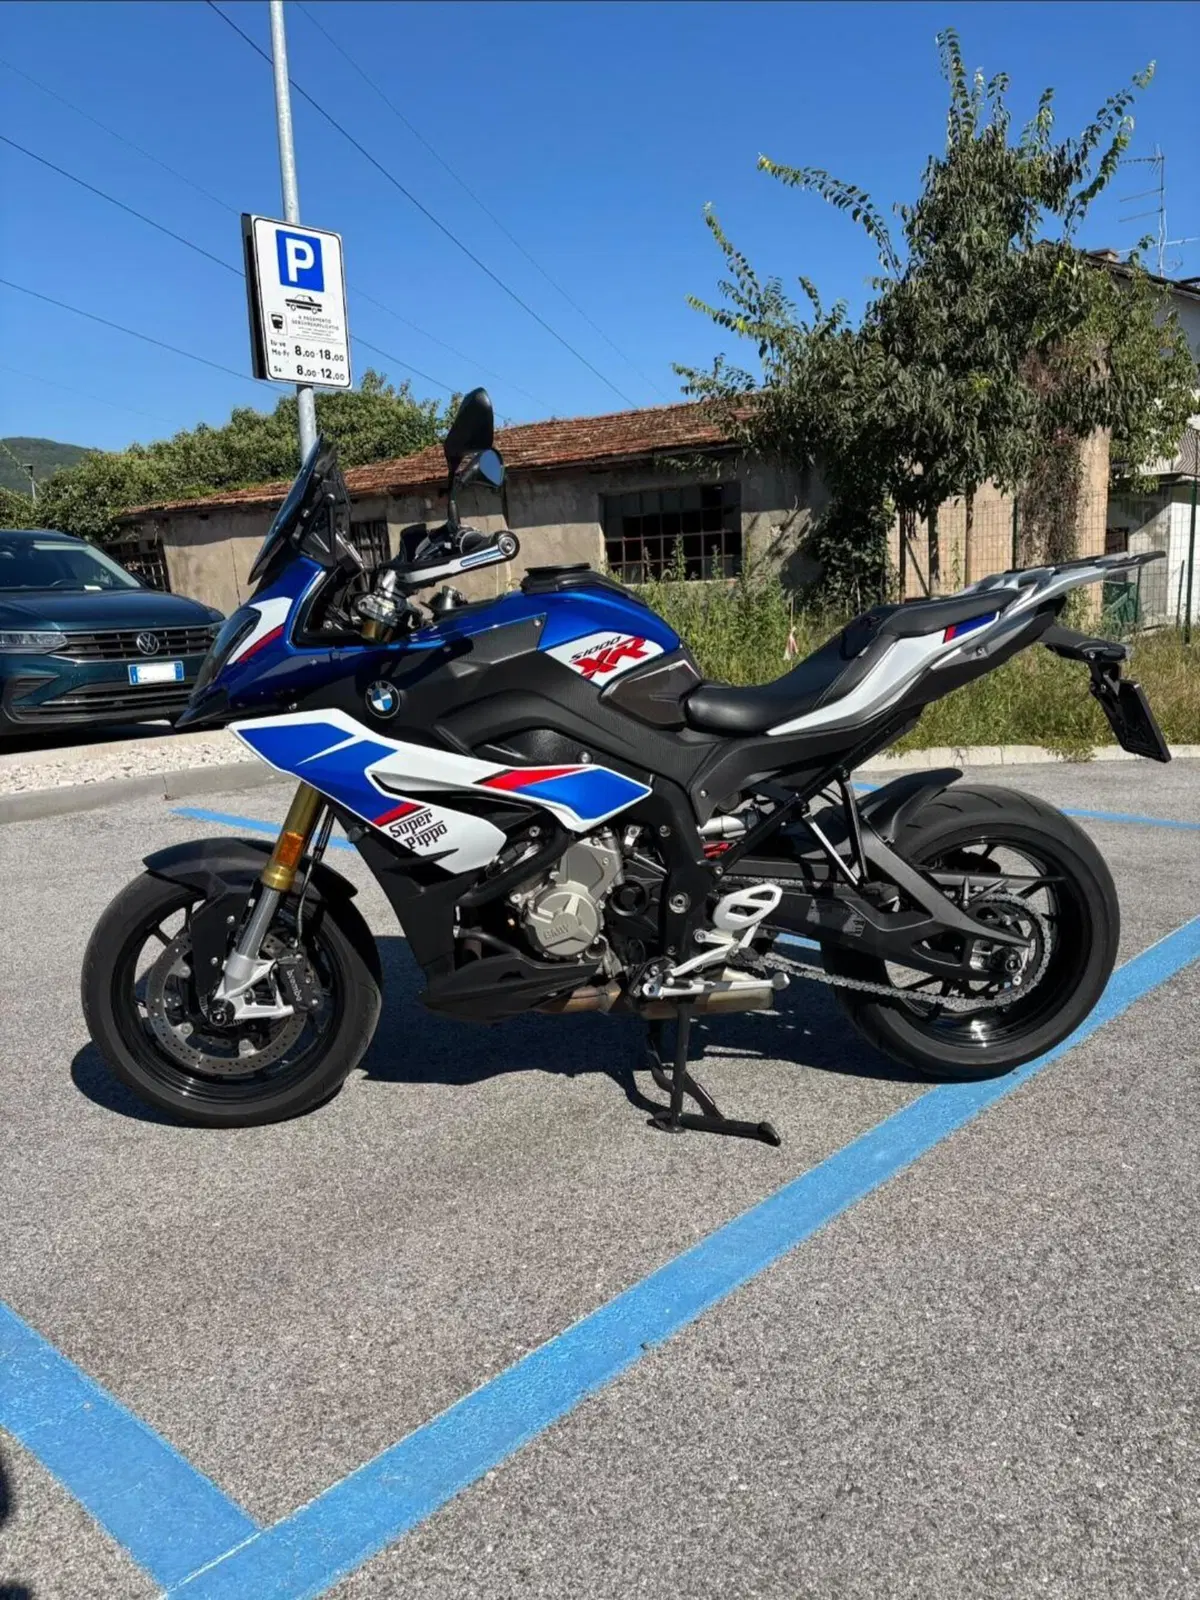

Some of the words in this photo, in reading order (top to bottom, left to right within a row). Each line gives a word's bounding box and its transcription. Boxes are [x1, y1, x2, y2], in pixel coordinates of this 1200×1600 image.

[285, 237, 315, 282] P
[570, 635, 622, 660] S1000
[572, 636, 649, 680] XR
[388, 808, 433, 838] Super
[403, 820, 448, 850] Pippo
[286, 968, 303, 1002] brembo
